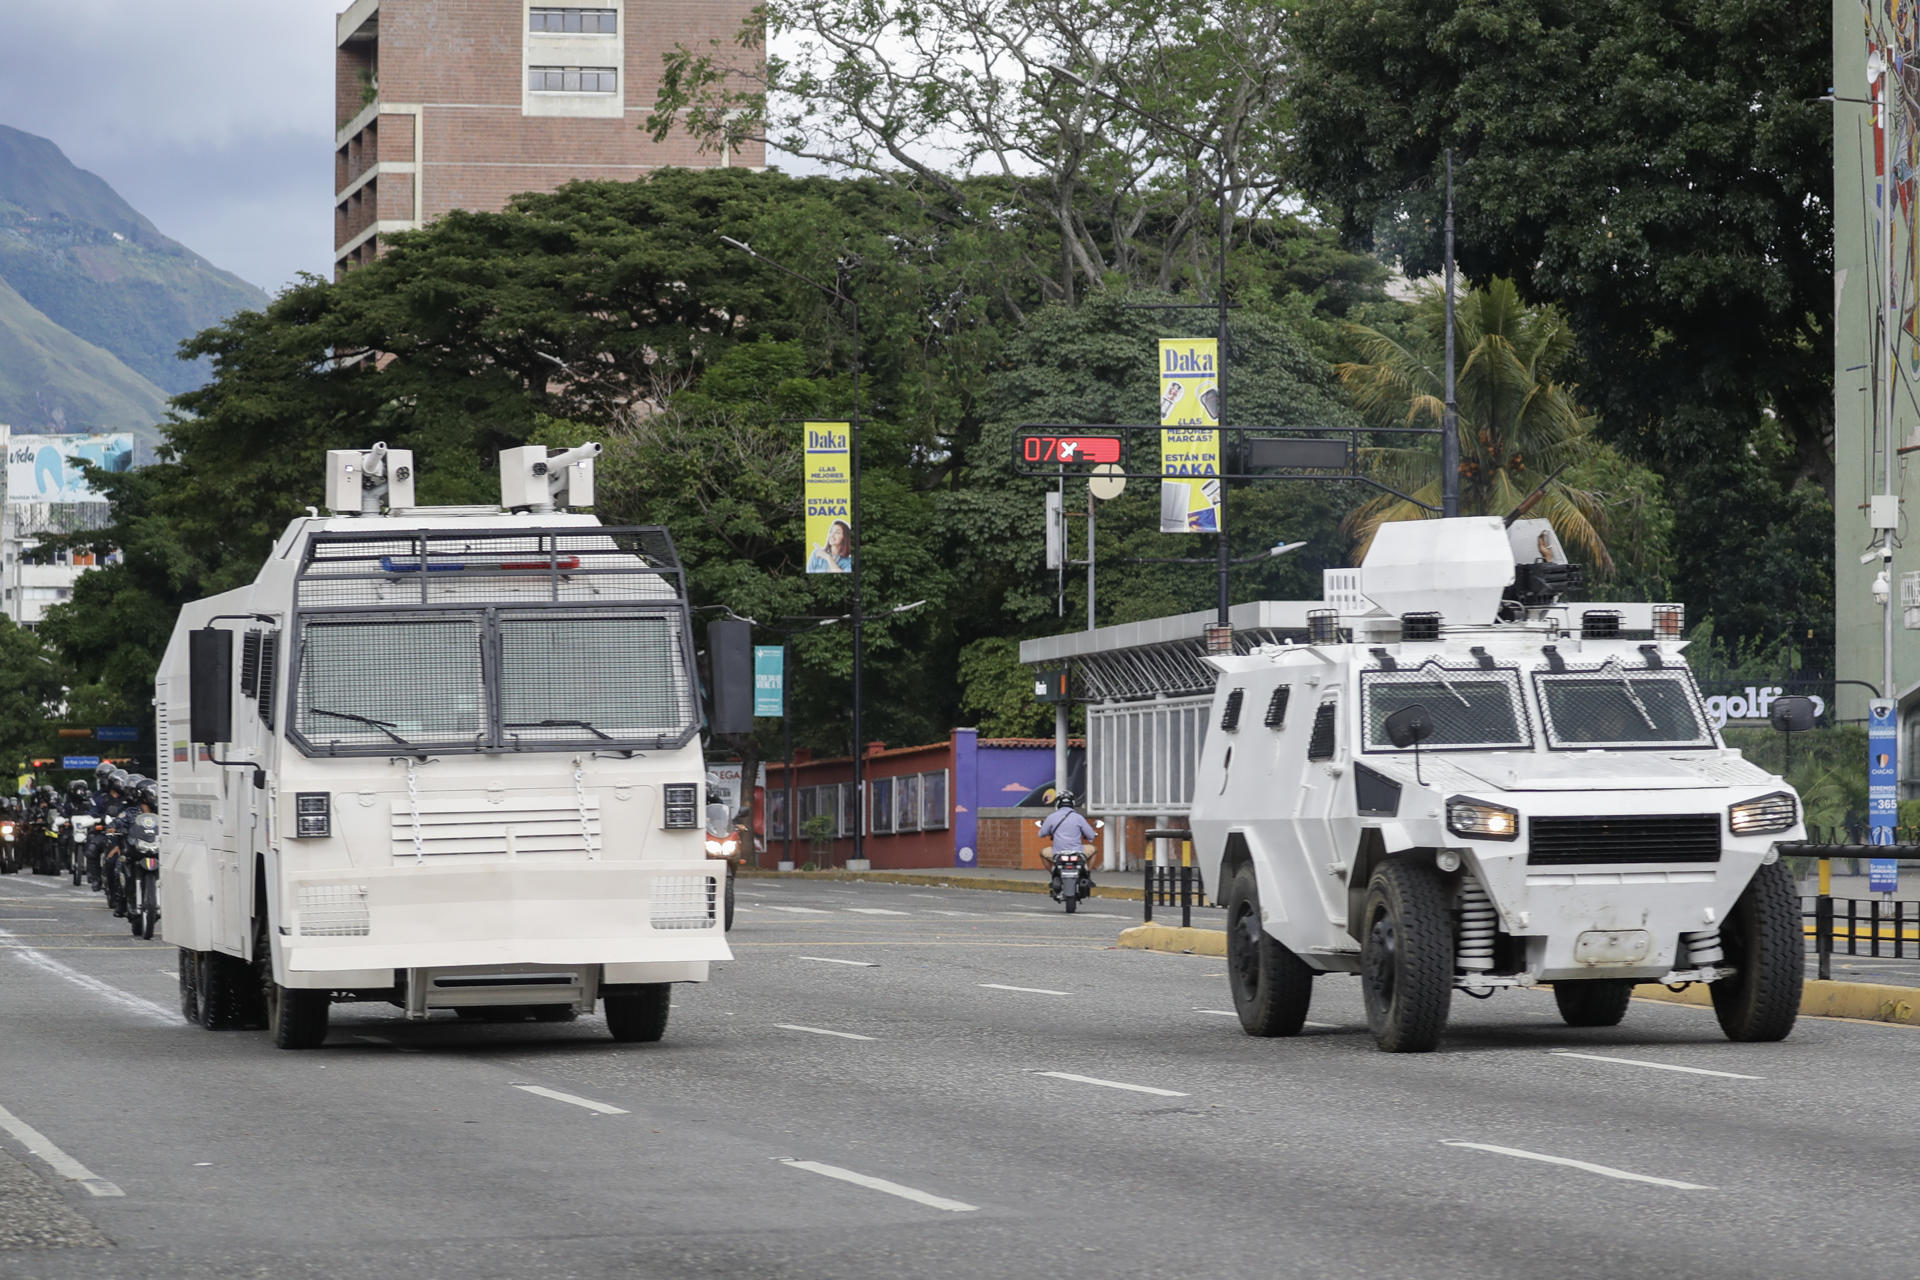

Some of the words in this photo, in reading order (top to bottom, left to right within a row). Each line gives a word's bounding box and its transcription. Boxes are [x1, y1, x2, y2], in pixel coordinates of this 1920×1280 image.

[1165, 348, 1213, 372] Daka
[808, 430, 846, 449] Daka
[9, 445, 35, 464] vida
[1024, 437, 1057, 462] 07
[1165, 452, 1199, 462] ESTÁN
[1202, 453, 1216, 461] EN
[1165, 463, 1216, 475] DAKA
[807, 497, 834, 505] ESTÁN
[807, 506, 848, 516] DAKA
[1878, 799, 1898, 809] 365
